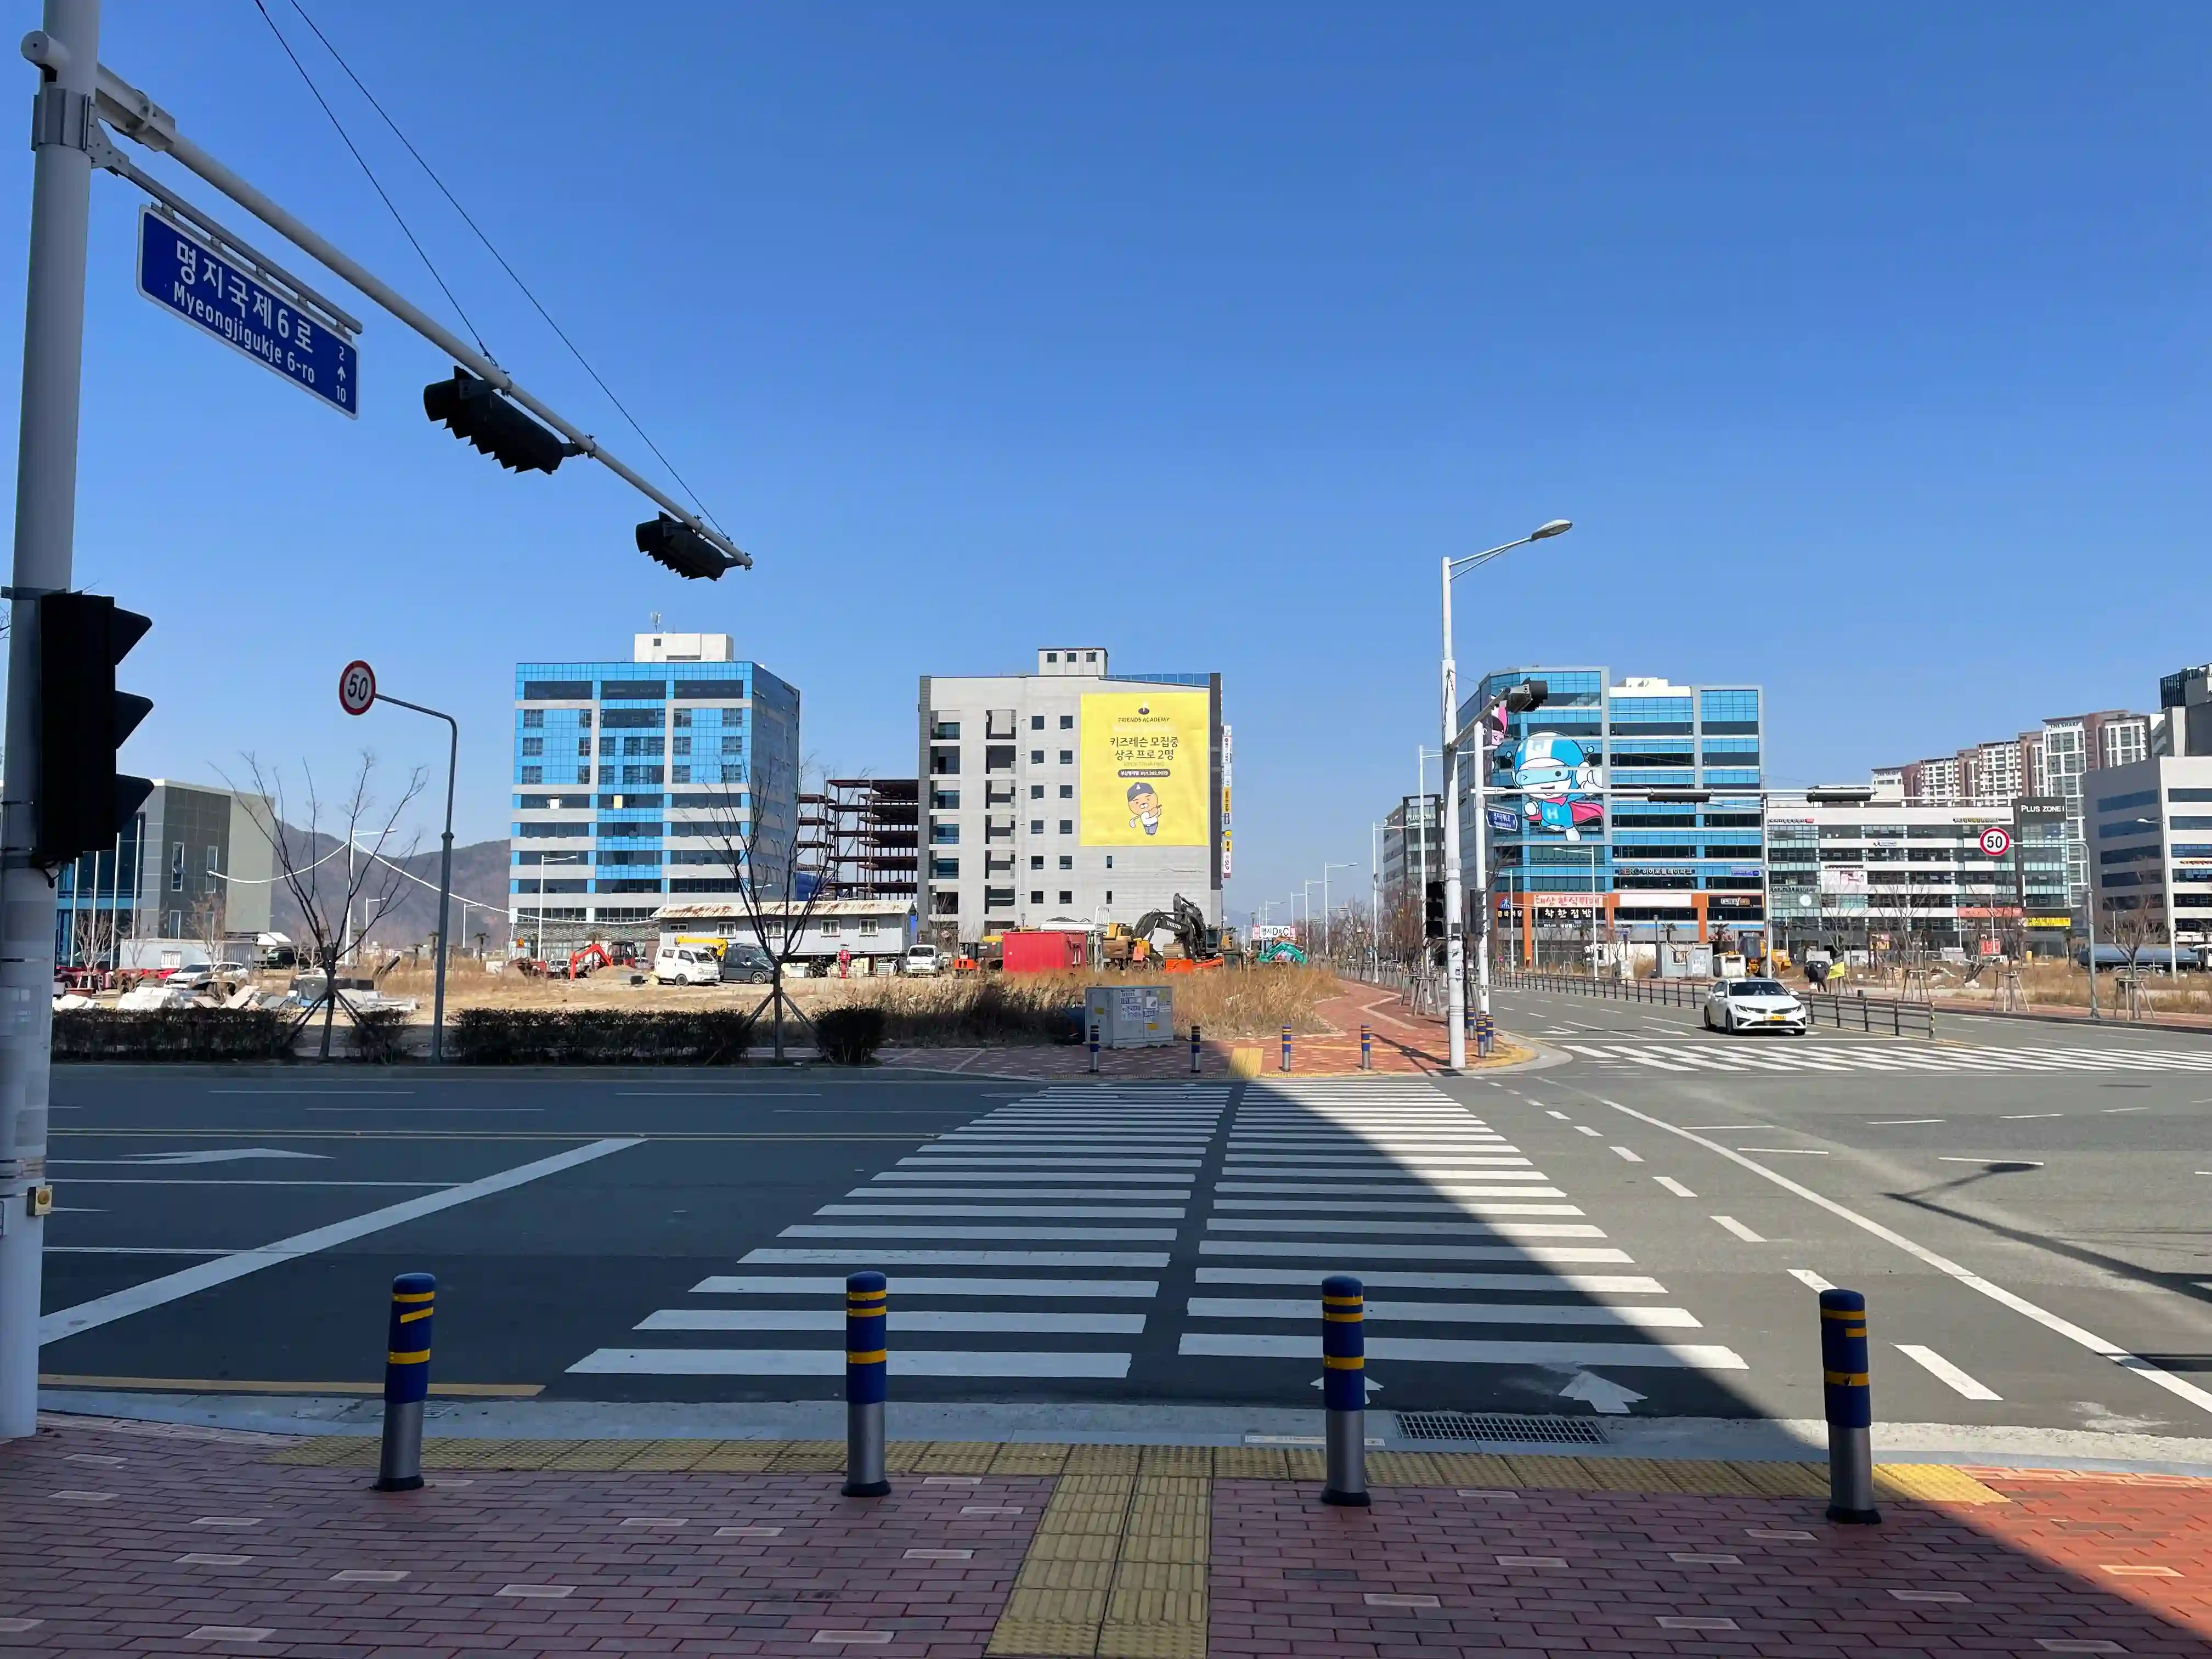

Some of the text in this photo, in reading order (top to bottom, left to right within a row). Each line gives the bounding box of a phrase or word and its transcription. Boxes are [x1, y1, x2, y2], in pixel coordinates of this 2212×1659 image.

[176, 240, 313, 353] 명지국제6로
[173, 280, 315, 383] Myeongjigukje 6-ro
[338, 346, 345, 361] 2
[336, 385, 347, 403] 10
[347, 673, 368, 701] 50
[1110, 736, 1180, 748] 키즈레슨 모집중
[1115, 749, 1174, 761] 상주 프로 2명
[1987, 836, 2003, 849] 50
[1166, 921, 1181, 930] VOLVO
